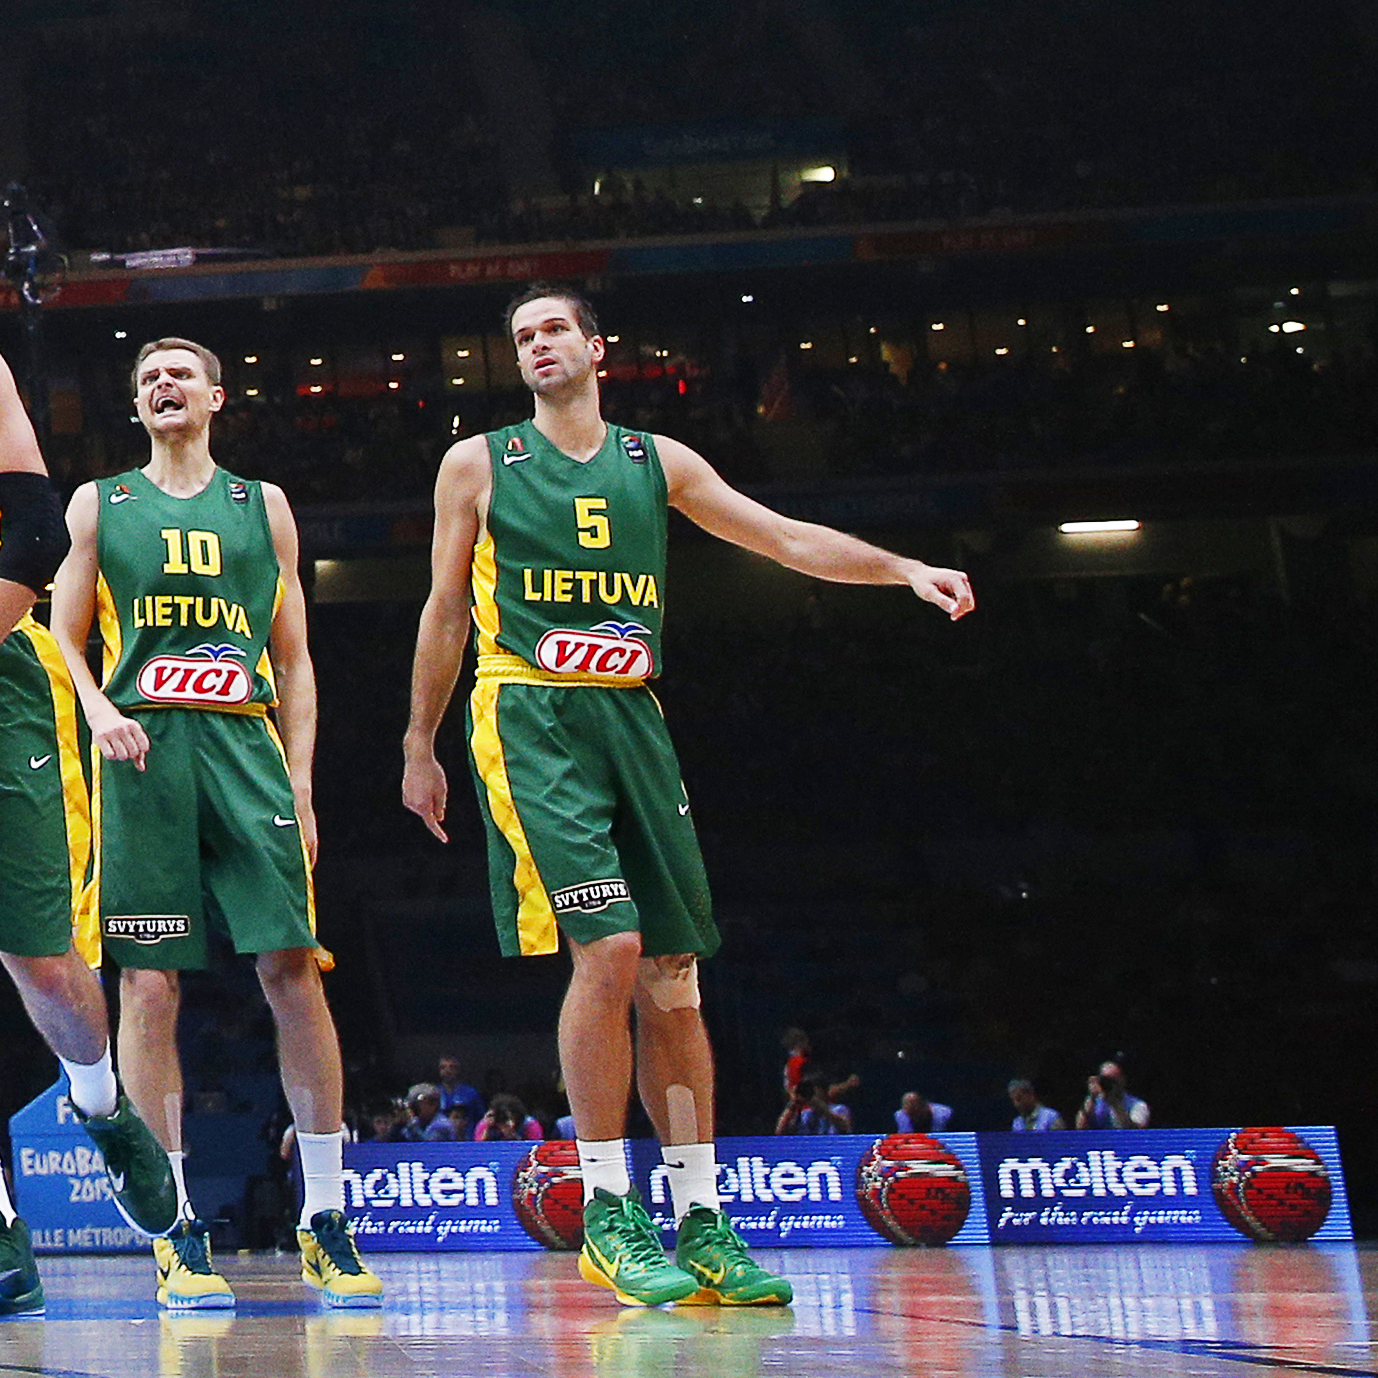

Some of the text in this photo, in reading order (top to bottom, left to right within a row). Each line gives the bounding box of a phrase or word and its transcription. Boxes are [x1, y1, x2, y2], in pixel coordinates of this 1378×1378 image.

[573, 496, 612, 550] 5
[161, 528, 222, 576] 10
[523, 568, 659, 609] LIETUVA
[133, 595, 252, 639] LIETUVA
[553, 639, 643, 674] VICI
[152, 666, 240, 697] VICI
[997, 1150, 1199, 1197] molten
